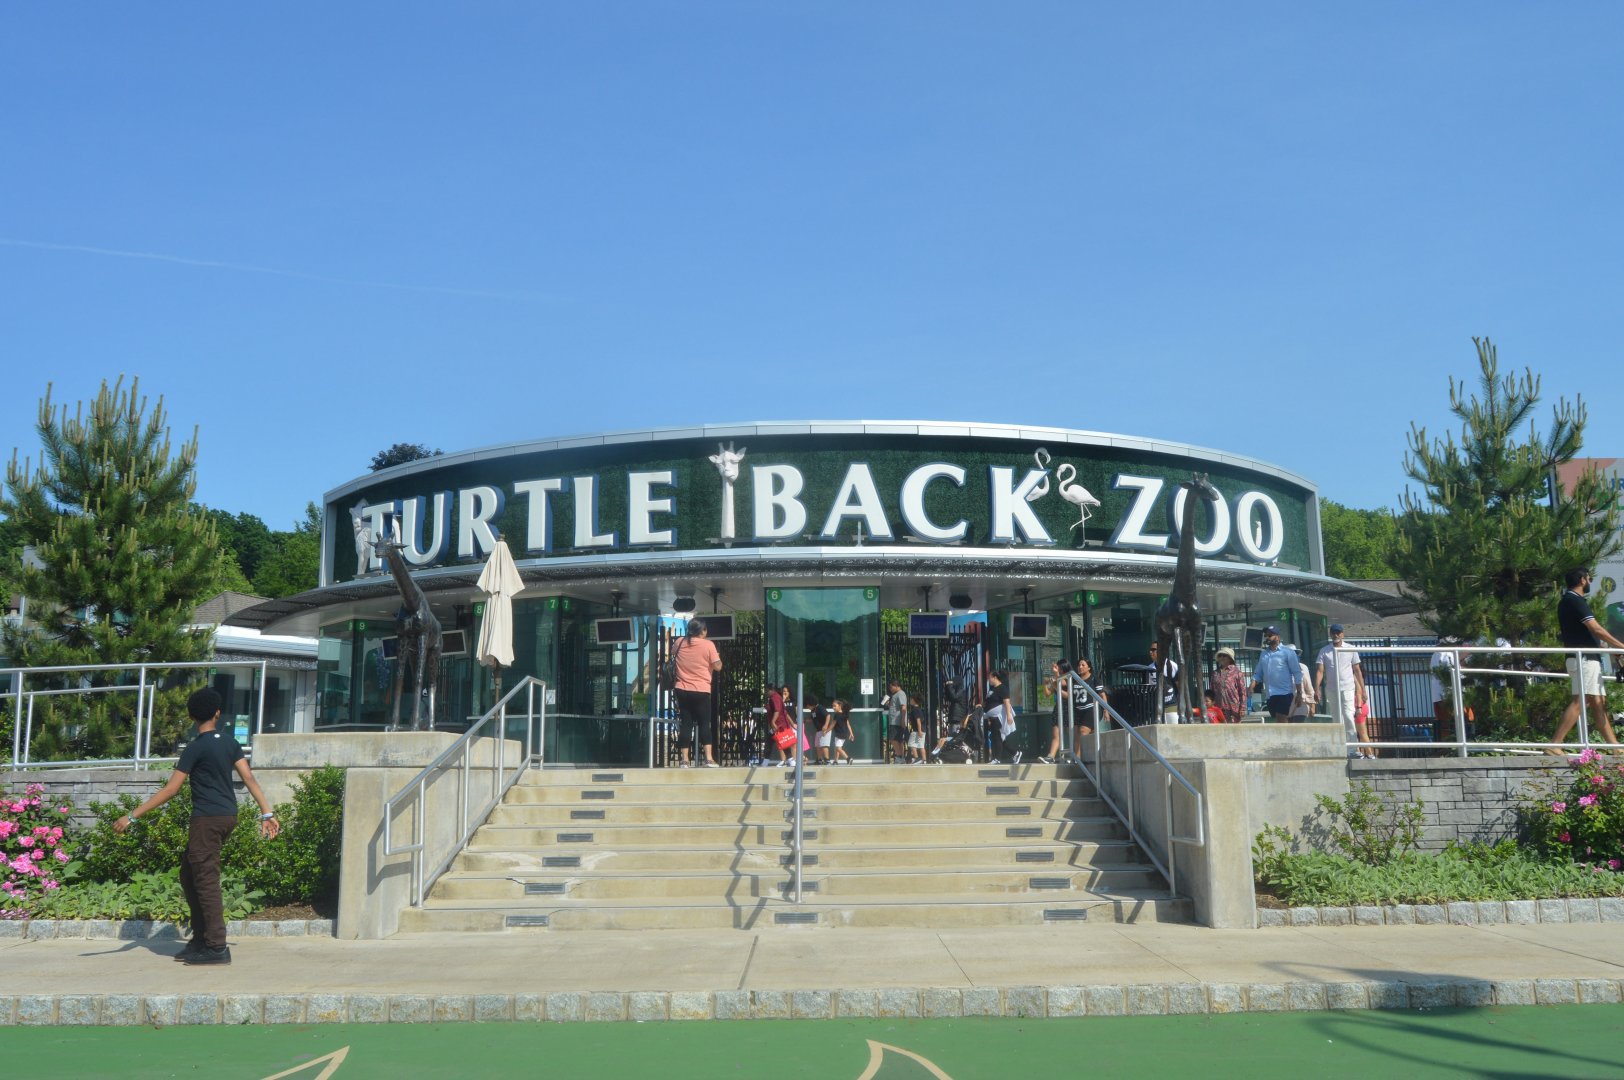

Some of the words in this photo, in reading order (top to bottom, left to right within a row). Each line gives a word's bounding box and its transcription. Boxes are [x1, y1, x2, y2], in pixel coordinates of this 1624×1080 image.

[361, 469, 677, 571] TURTLE
[751, 461, 1056, 545] BACK
[1109, 472, 1284, 563] ZOO
[771, 590, 778, 600] 6
[867, 589, 874, 599] 5
[551, 599, 557, 609] 7
[476, 605, 483, 614] 8
[1073, 688, 1088, 703] 23
